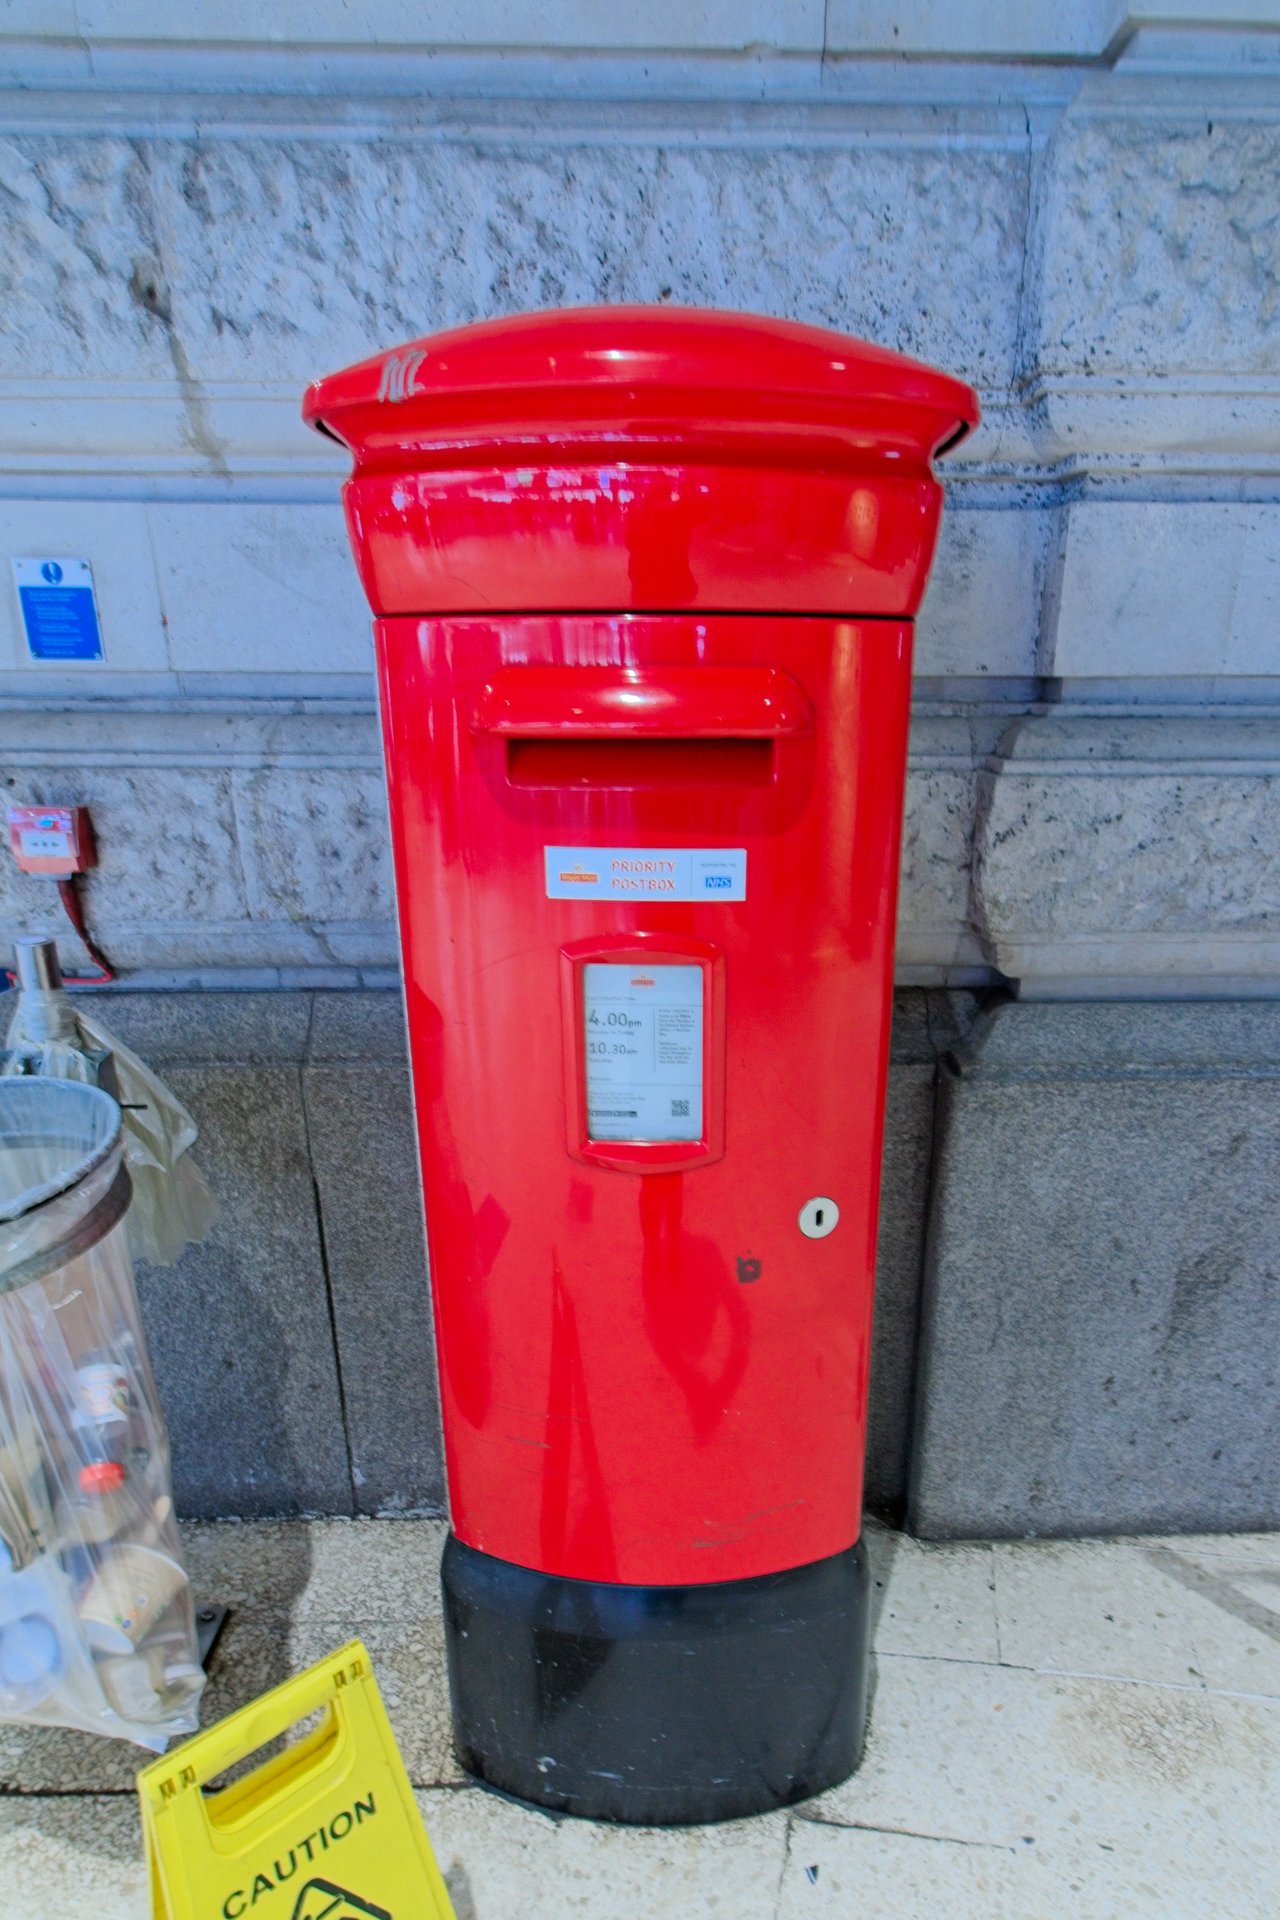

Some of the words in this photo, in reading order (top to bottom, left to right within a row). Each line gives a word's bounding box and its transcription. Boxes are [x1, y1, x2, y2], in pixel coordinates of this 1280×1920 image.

[612, 860, 676, 873] PRIORITY
[612, 878, 675, 892] POSTBOX
[707, 878, 730, 888] NHS
[589, 1009, 642, 1028] 4.00pm
[589, 1042, 638, 1055] 10.30am
[223, 1791, 377, 1919] CAUTION
